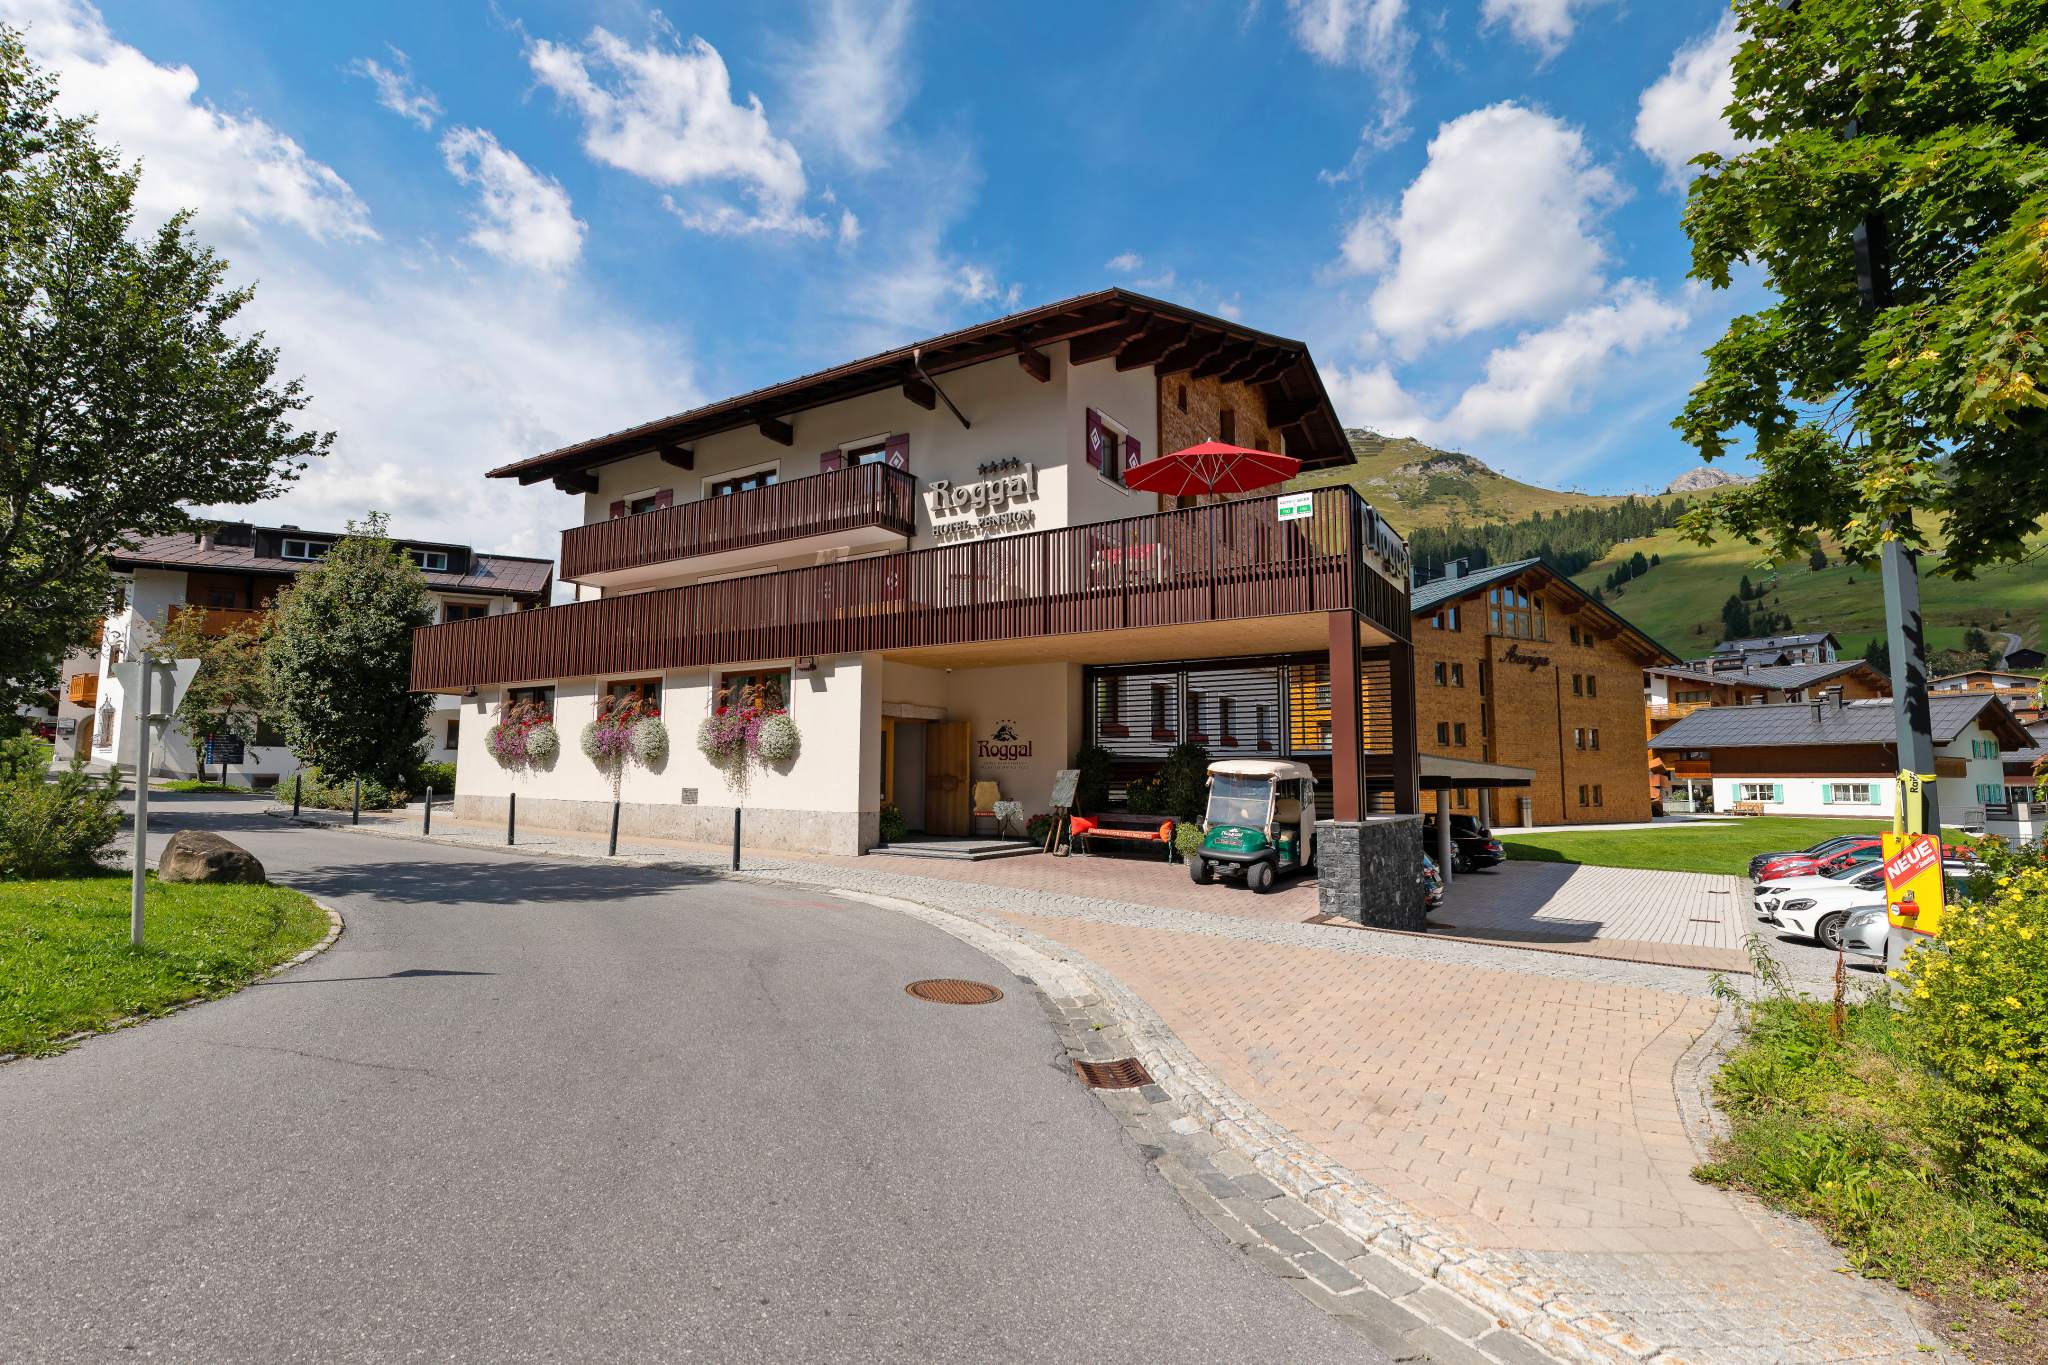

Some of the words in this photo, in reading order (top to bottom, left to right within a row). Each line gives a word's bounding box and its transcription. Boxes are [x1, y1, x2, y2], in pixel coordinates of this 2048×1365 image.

[929, 462, 1036, 511] Roggal
[932, 520, 969, 536] HOTEL
[977, 509, 1033, 528] PENSION
[978, 741, 1032, 760] Roggal
[1887, 840, 1933, 880] NEUE
